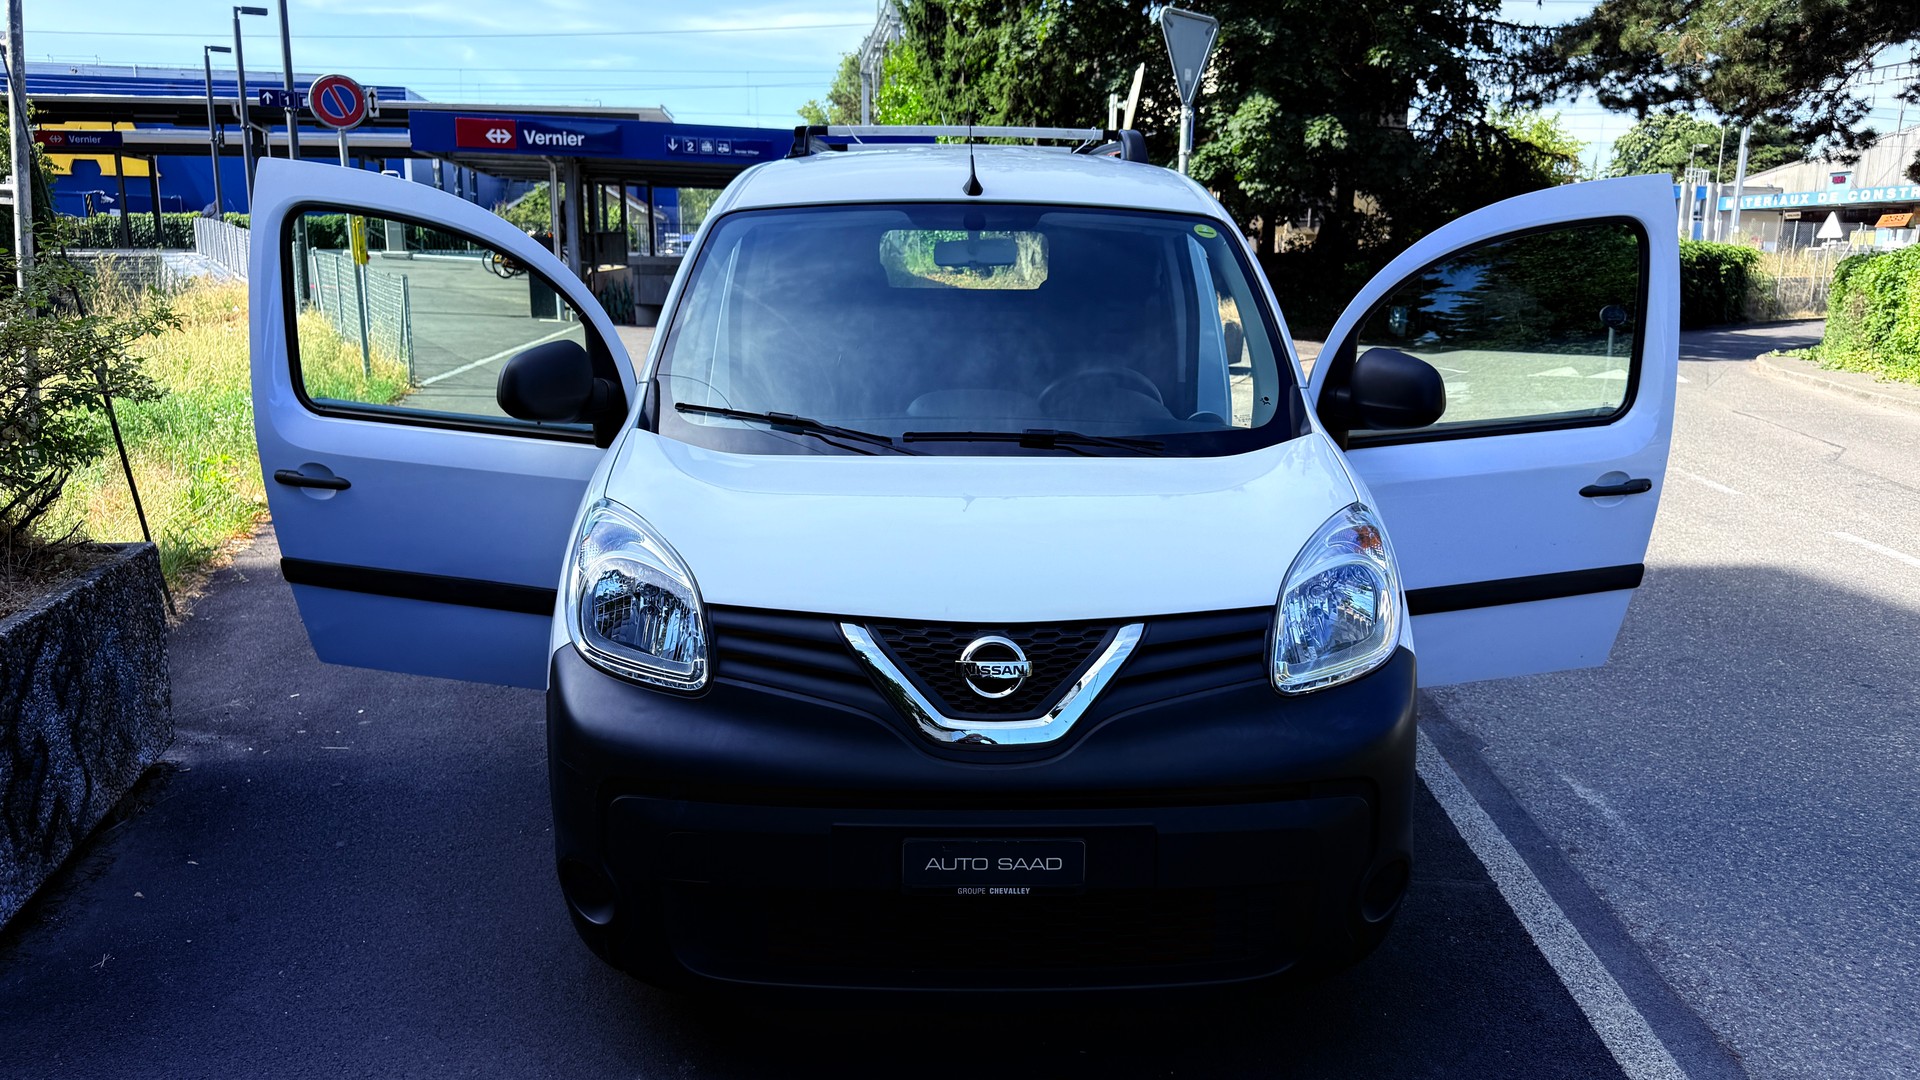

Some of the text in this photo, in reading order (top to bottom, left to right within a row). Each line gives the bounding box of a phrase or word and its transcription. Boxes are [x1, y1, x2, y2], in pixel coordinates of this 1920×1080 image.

[68, 134, 102, 144] Vernier
[523, 129, 585, 147] Vernier
[687, 142, 695, 152] 2
[1818, 192, 1838, 203] DE
[963, 664, 1025, 677] NISSAN
[925, 857, 1063, 871] AUTO SAAD
[957, 887, 1031, 895] GROUPE CHEVALLEY
